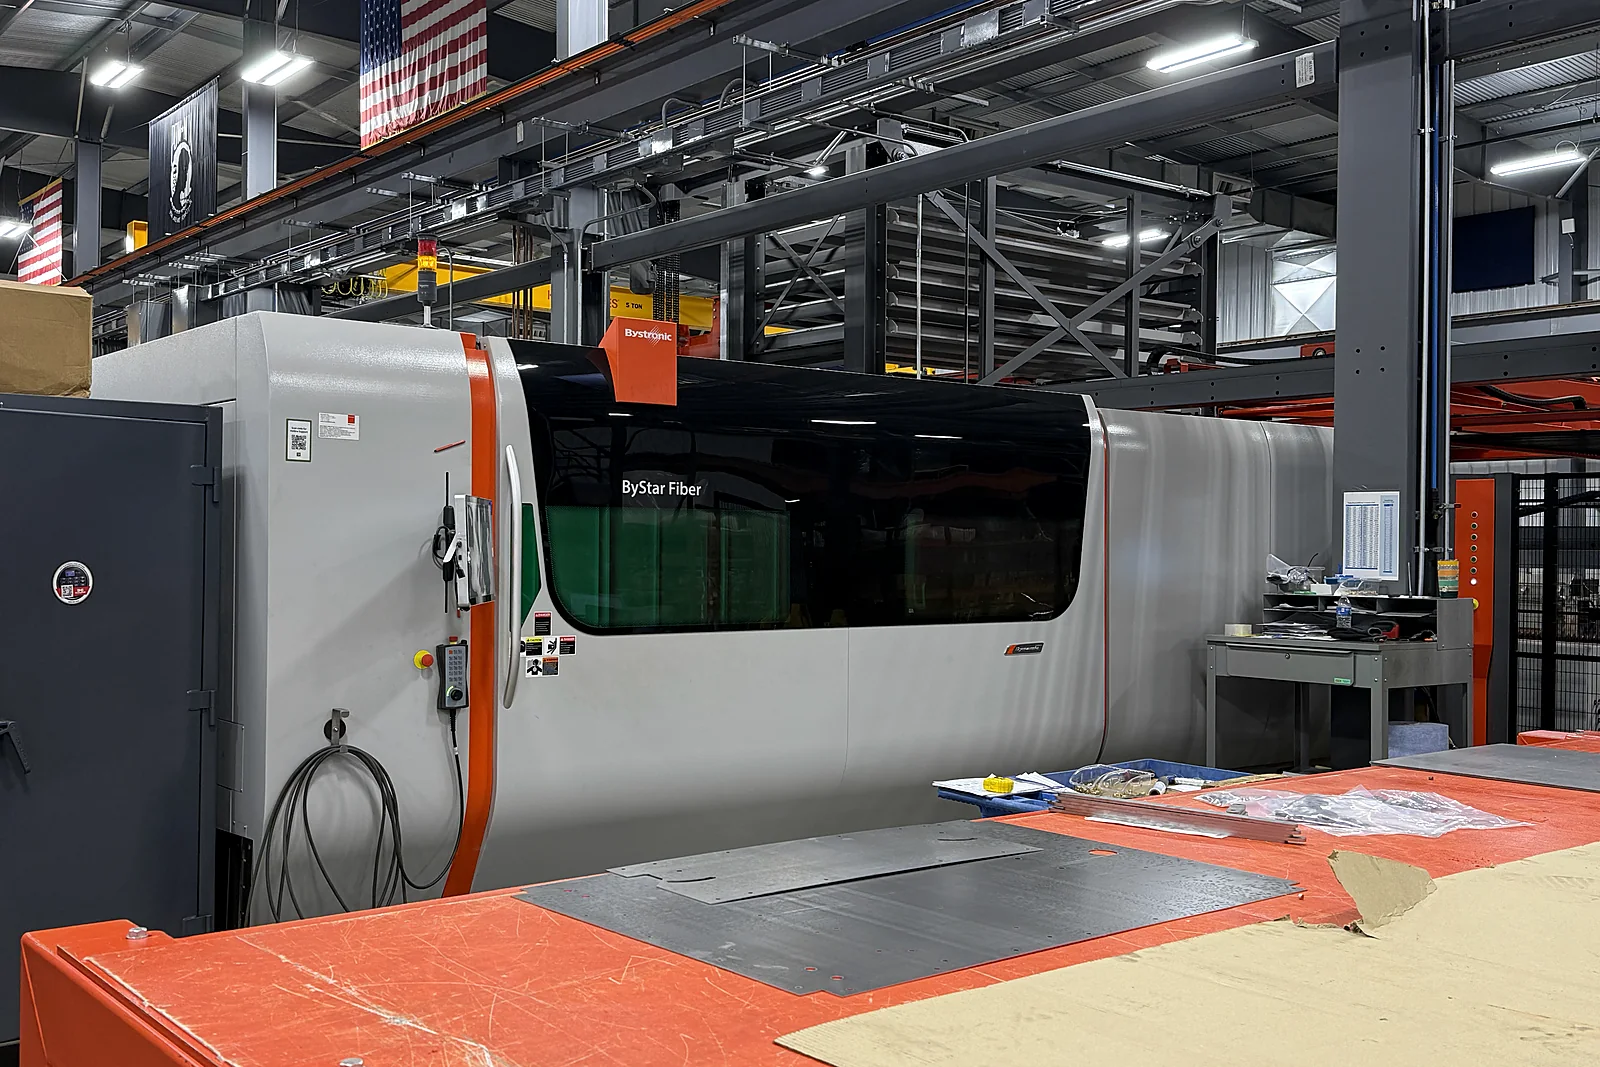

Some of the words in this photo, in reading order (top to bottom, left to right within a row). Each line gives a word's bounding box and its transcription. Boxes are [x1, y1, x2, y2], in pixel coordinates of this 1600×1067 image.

[631, 302, 643, 310] TON
[624, 328, 672, 341] Bystronic
[622, 480, 665, 498] ByStar
[668, 481, 702, 496] Fiber
